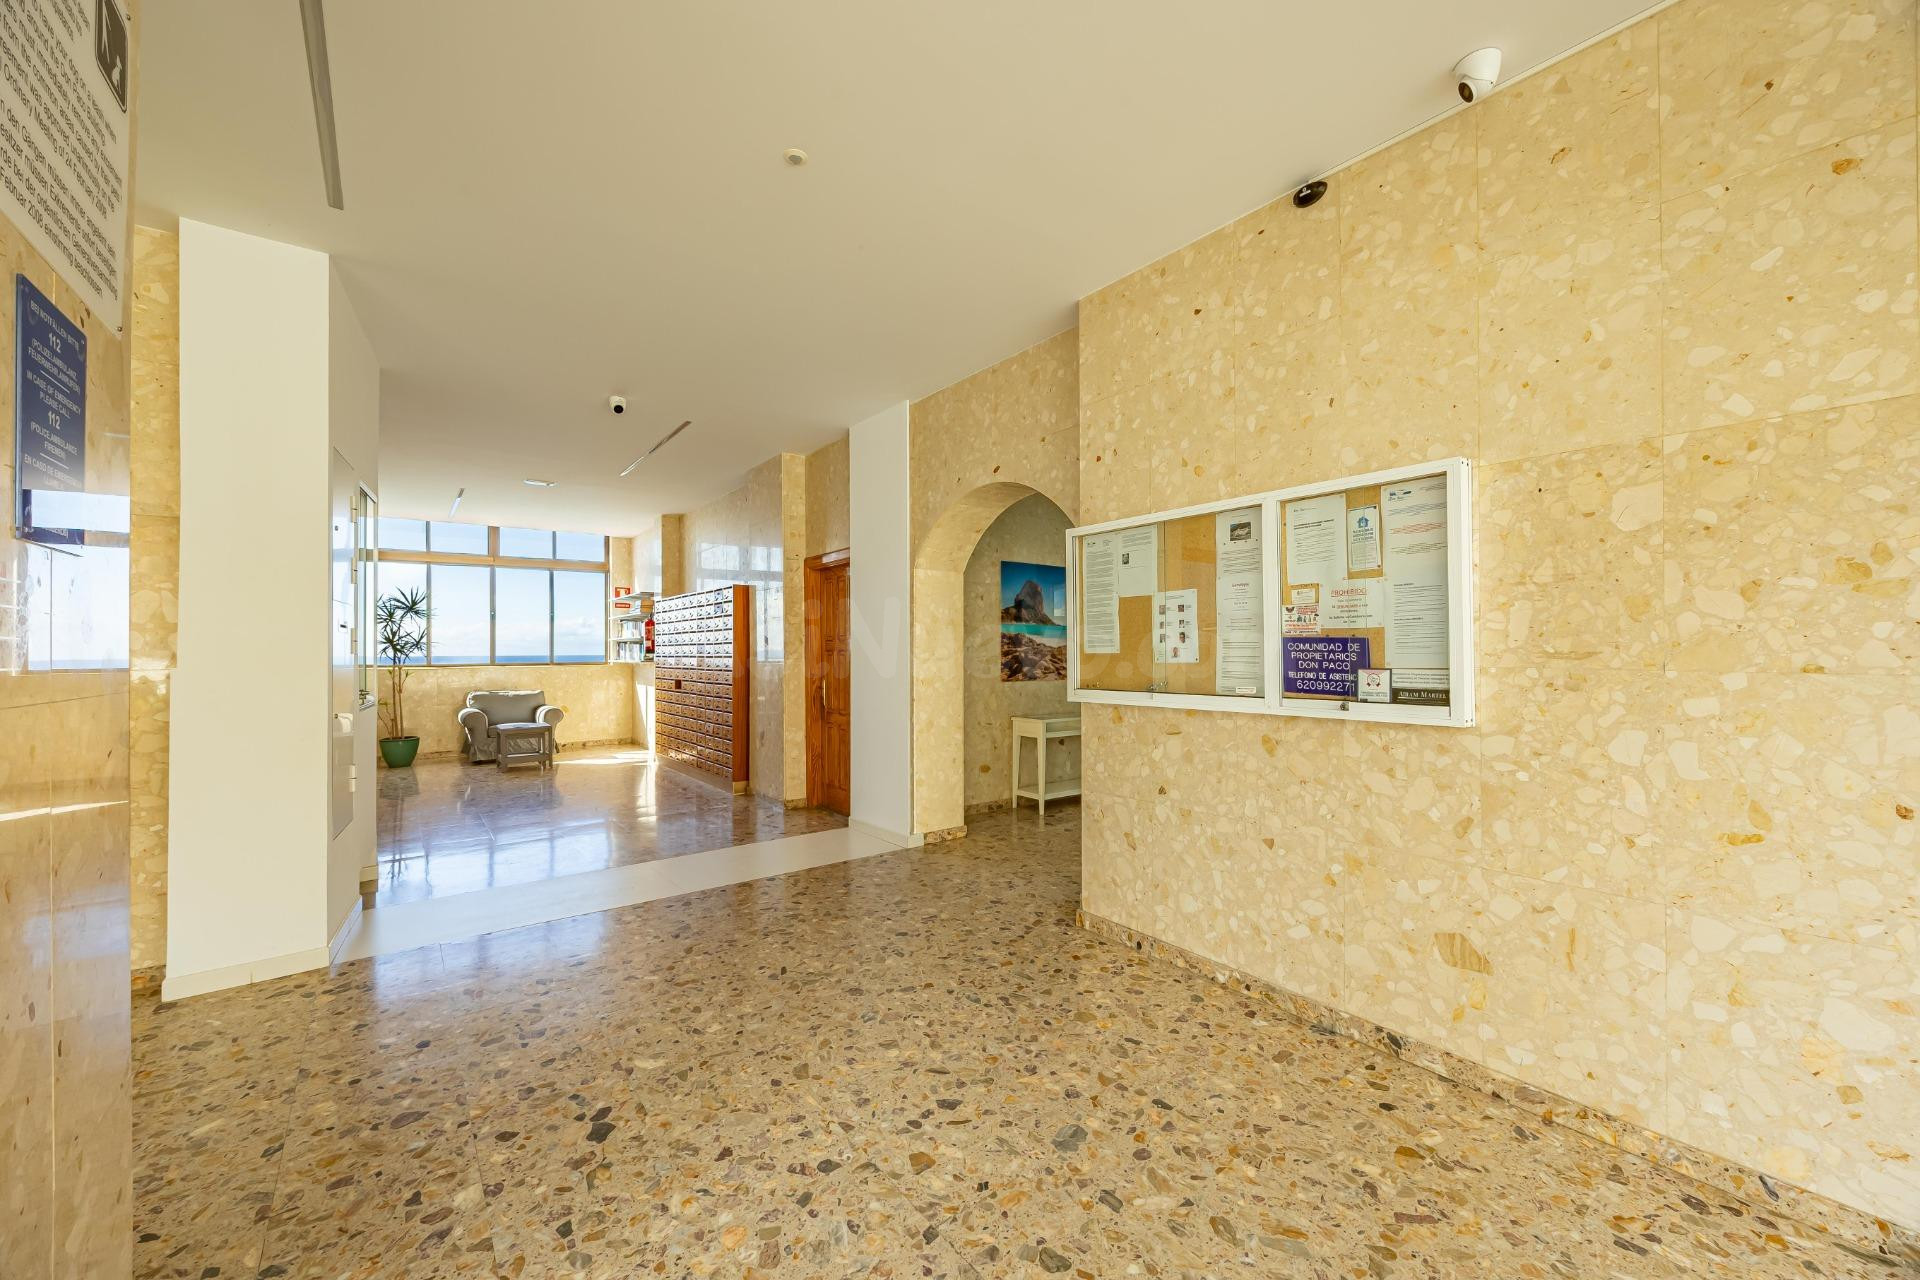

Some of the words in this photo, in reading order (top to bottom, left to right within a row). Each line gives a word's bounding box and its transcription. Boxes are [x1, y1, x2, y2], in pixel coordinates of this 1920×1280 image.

[27, 11, 48, 51] around
[49, 44, 58, 68] the
[60, 62, 71, 88] Don
[73, 82, 85, 112] Paco
[39, 8, 54, 40] have
[56, 38, 67, 61] your
[68, 57, 78, 83] dog
[3, 15, 19, 48] from
[21, 43, 30, 67] the
[32, 65, 58, 109] common
[59, 106, 74, 134] areas
[75, 131, 93, 162] caused
[19, 21, 34, 51] must
[36, 46, 70, 109] immediately
[71, 105, 90, 139] remove
[4, 63, 32, 117] Ordinary
[34, 107, 57, 152] Meeting
[73, 163, 94, 204] February
[29, 82, 42, 106] was
[43, 103, 69, 146] approved
[71, 144, 100, 192] unanimously
[6, 106, 19, 134] den
[71, 195, 85, 219] immer
[13, 160, 23, 183] bei
[25, 175, 35, 198] der
[37, 193, 70, 240] ordentlichen
[44, 223, 73, 266] einstimmig
[48, 333, 61, 353] 112
[33, 374, 47, 392] CASE
[54, 388, 80, 415] EMERGENCY
[40, 392, 58, 411] PLEASE
[59, 404, 70, 419] CALL
[48, 410, 61, 430] 112
[24, 454, 31, 465] EN
[32, 457, 47, 471] CASO
[47, 464, 53, 475] DE
[1287, 643, 1343, 651] COMUNIDAD
[1347, 643, 1361, 652] DE
[1291, 652, 1357, 661] PROPIETARIOS
[1298, 660, 1319, 669] DON
[1323, 661, 1351, 670] PACO
[1288, 671, 1317, 680] TELEFONO
[1319, 672, 1327, 680] DE
[1329, 673, 1358, 681] ASISTENC
[1296, 680, 1356, 692] 620992271
